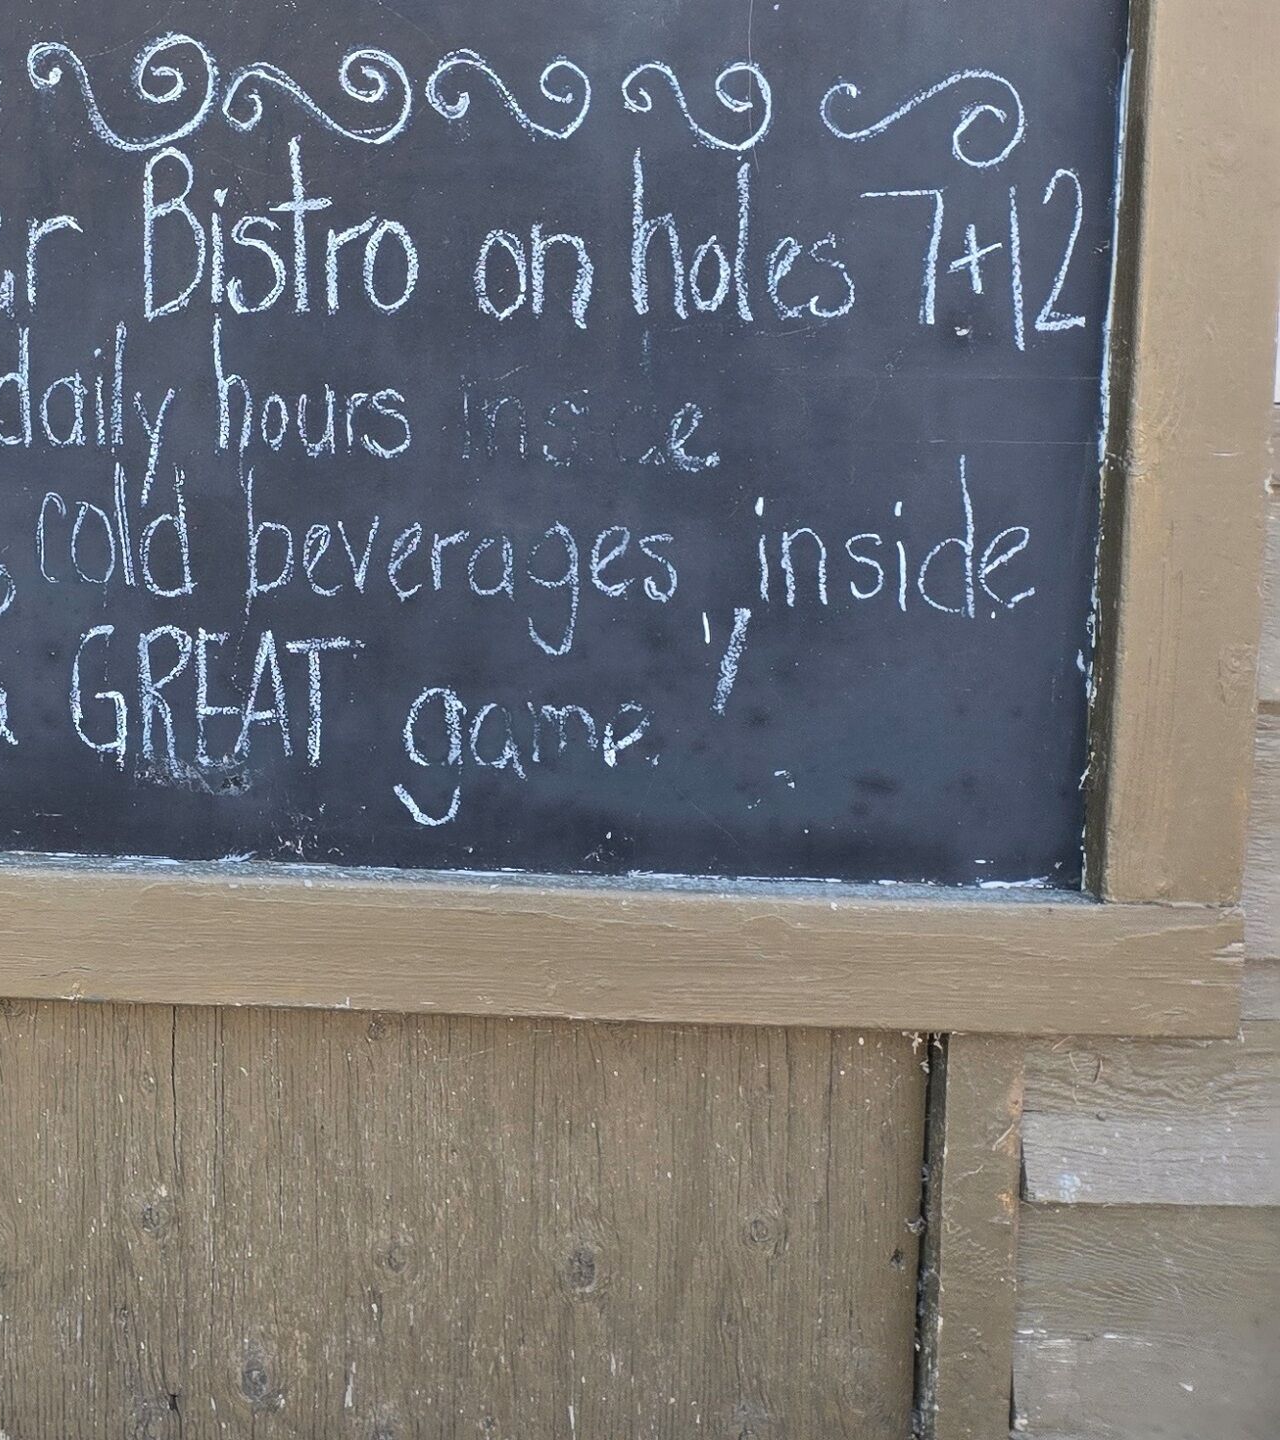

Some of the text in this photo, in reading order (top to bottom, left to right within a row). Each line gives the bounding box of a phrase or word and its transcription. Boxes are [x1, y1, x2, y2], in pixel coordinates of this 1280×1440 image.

[142, 134, 421, 322] Bistro
[473, 222, 596, 329] on
[629, 147, 857, 322] holes
[212, 315, 415, 457] hours
[70, 623, 366, 778] GREAT
